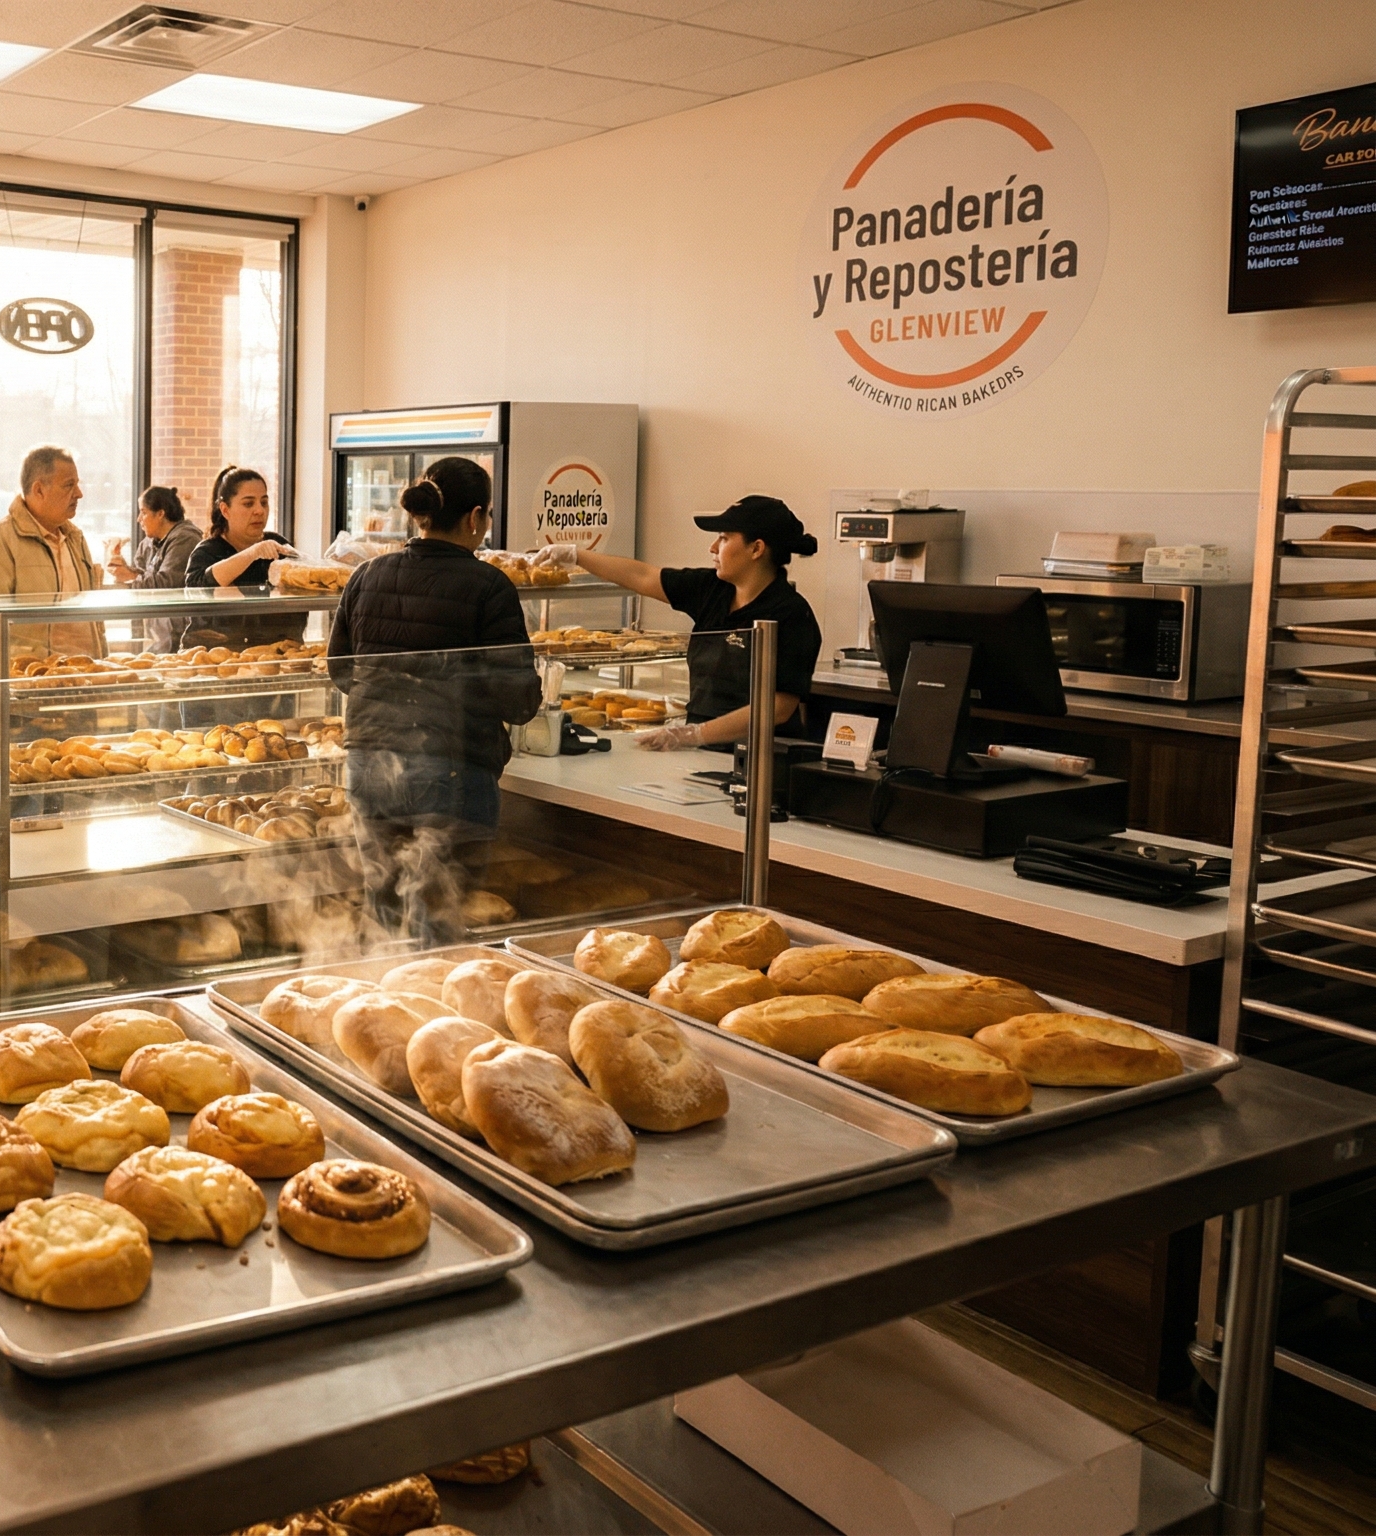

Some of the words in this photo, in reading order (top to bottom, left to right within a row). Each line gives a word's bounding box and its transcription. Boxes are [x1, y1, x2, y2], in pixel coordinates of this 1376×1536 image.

[1292, 107, 1376, 152] Ban
[832, 174, 1044, 251] Panadería
[812, 272, 833, 319] y
[845, 228, 1079, 310] Repostería
[870, 306, 1006, 344] GLENVIEW
[916, 396, 957, 412] RICAN
[544, 488, 602, 507] Panadería
[537, 513, 544, 531] y
[547, 506, 608, 530] Repostería
